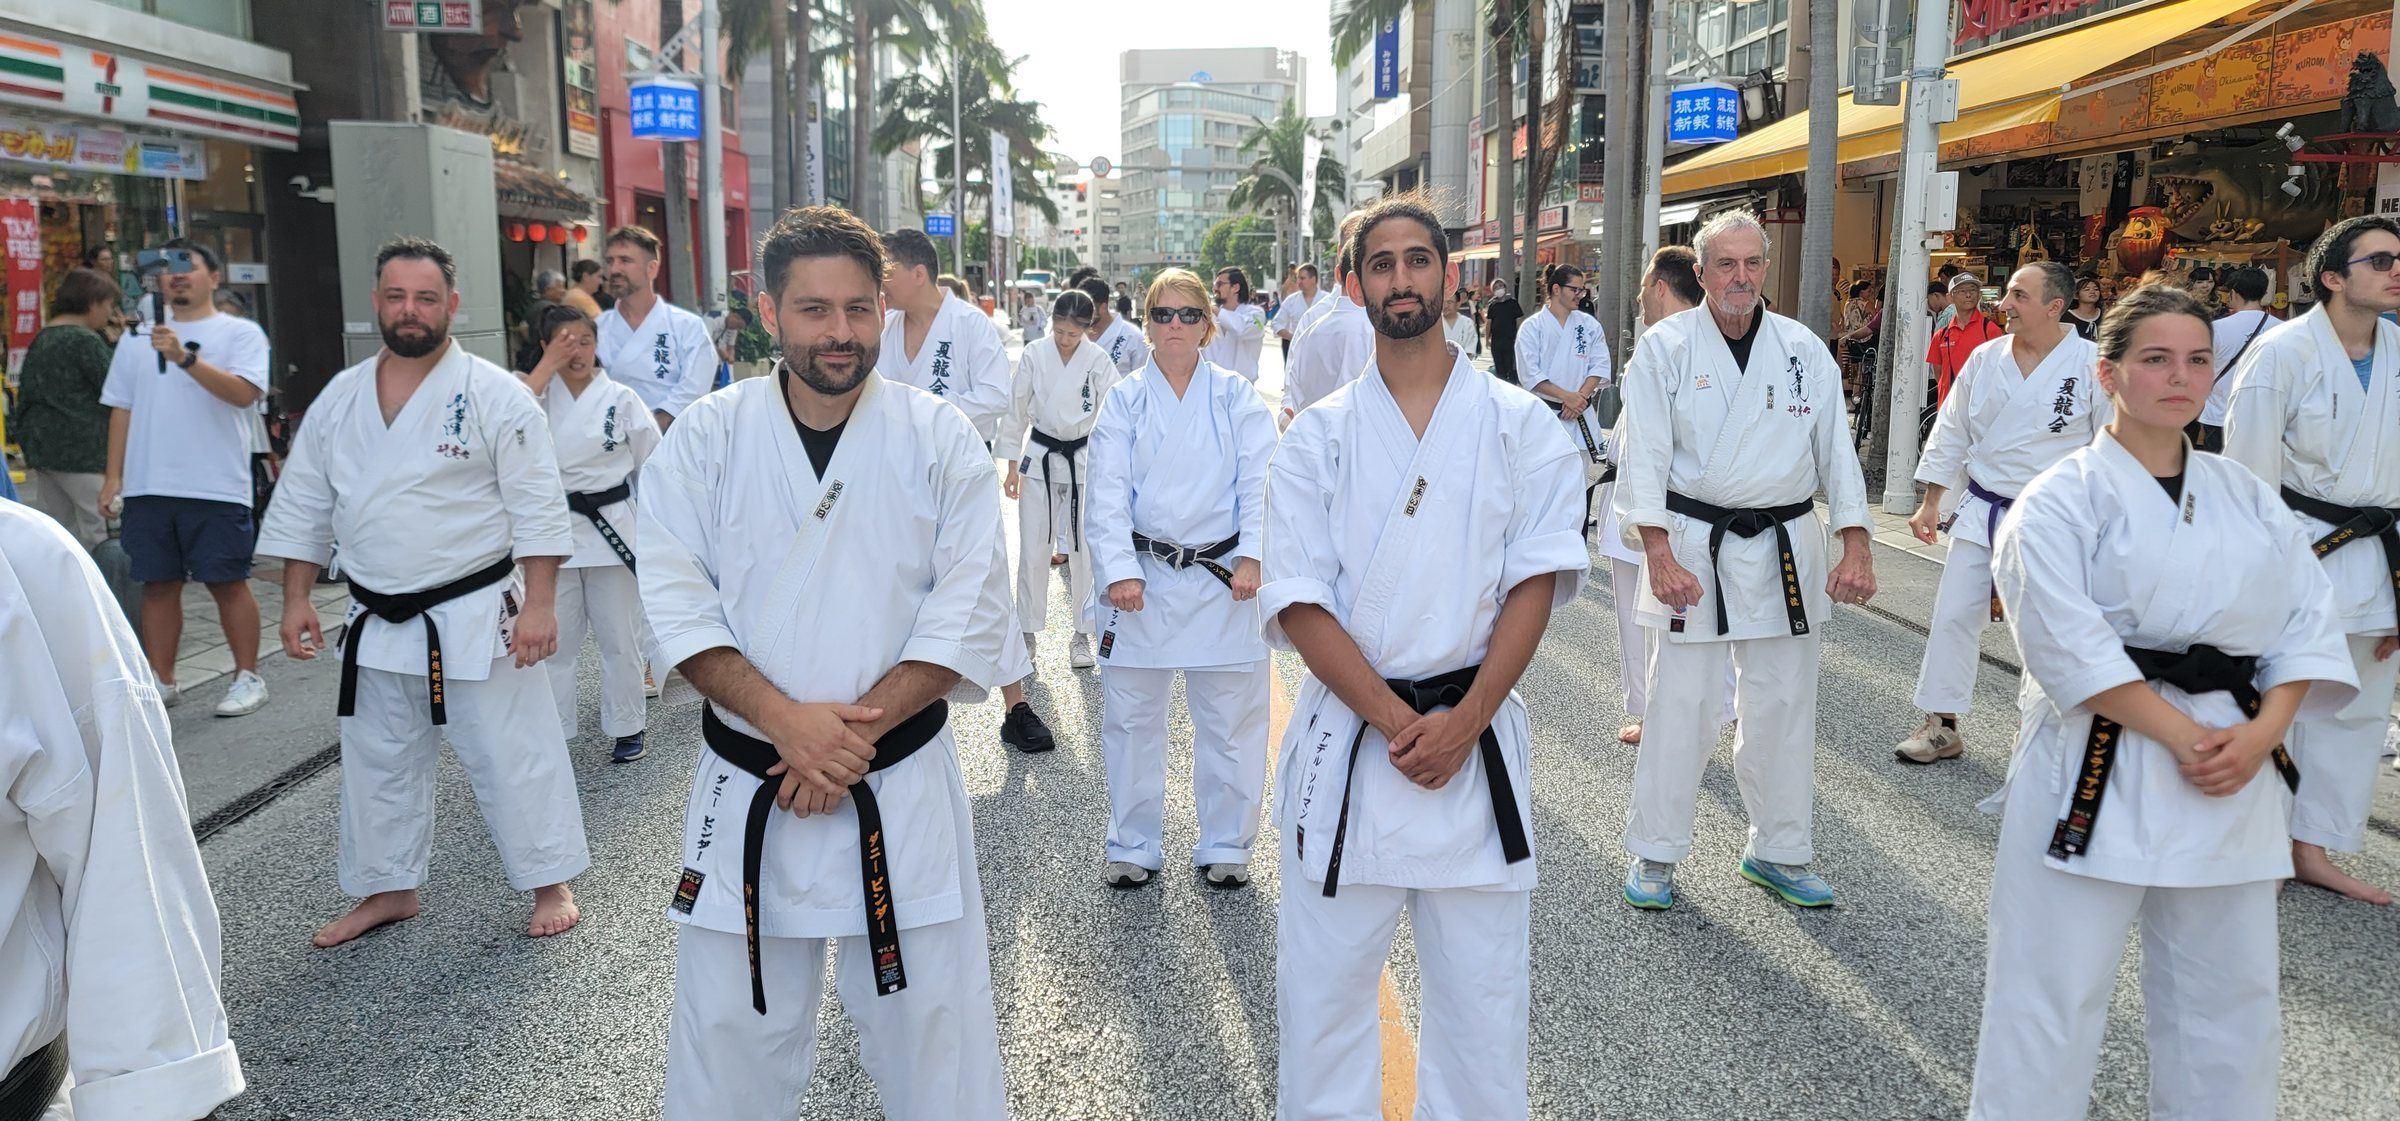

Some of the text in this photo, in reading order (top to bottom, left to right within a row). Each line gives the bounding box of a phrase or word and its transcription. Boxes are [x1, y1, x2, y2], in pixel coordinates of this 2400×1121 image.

[421, 7, 438, 24] 酒
[2295, 57, 2325, 71] KUROMI
[2219, 74, 2254, 87] Okinawa
[2171, 84, 2195, 96] KUROMI
[1674, 97, 1711, 114] 琉球
[1674, 115, 1711, 132] 新報
[654, 333, 669, 379] 夏龍会
[2048, 377, 2079, 433] 夏龍会
[1300, 731, 1332, 820] アデル ソリマン
[696, 773, 730, 862] ダニー ビンダー
[868, 830, 888, 934] ダニー ビンダー
